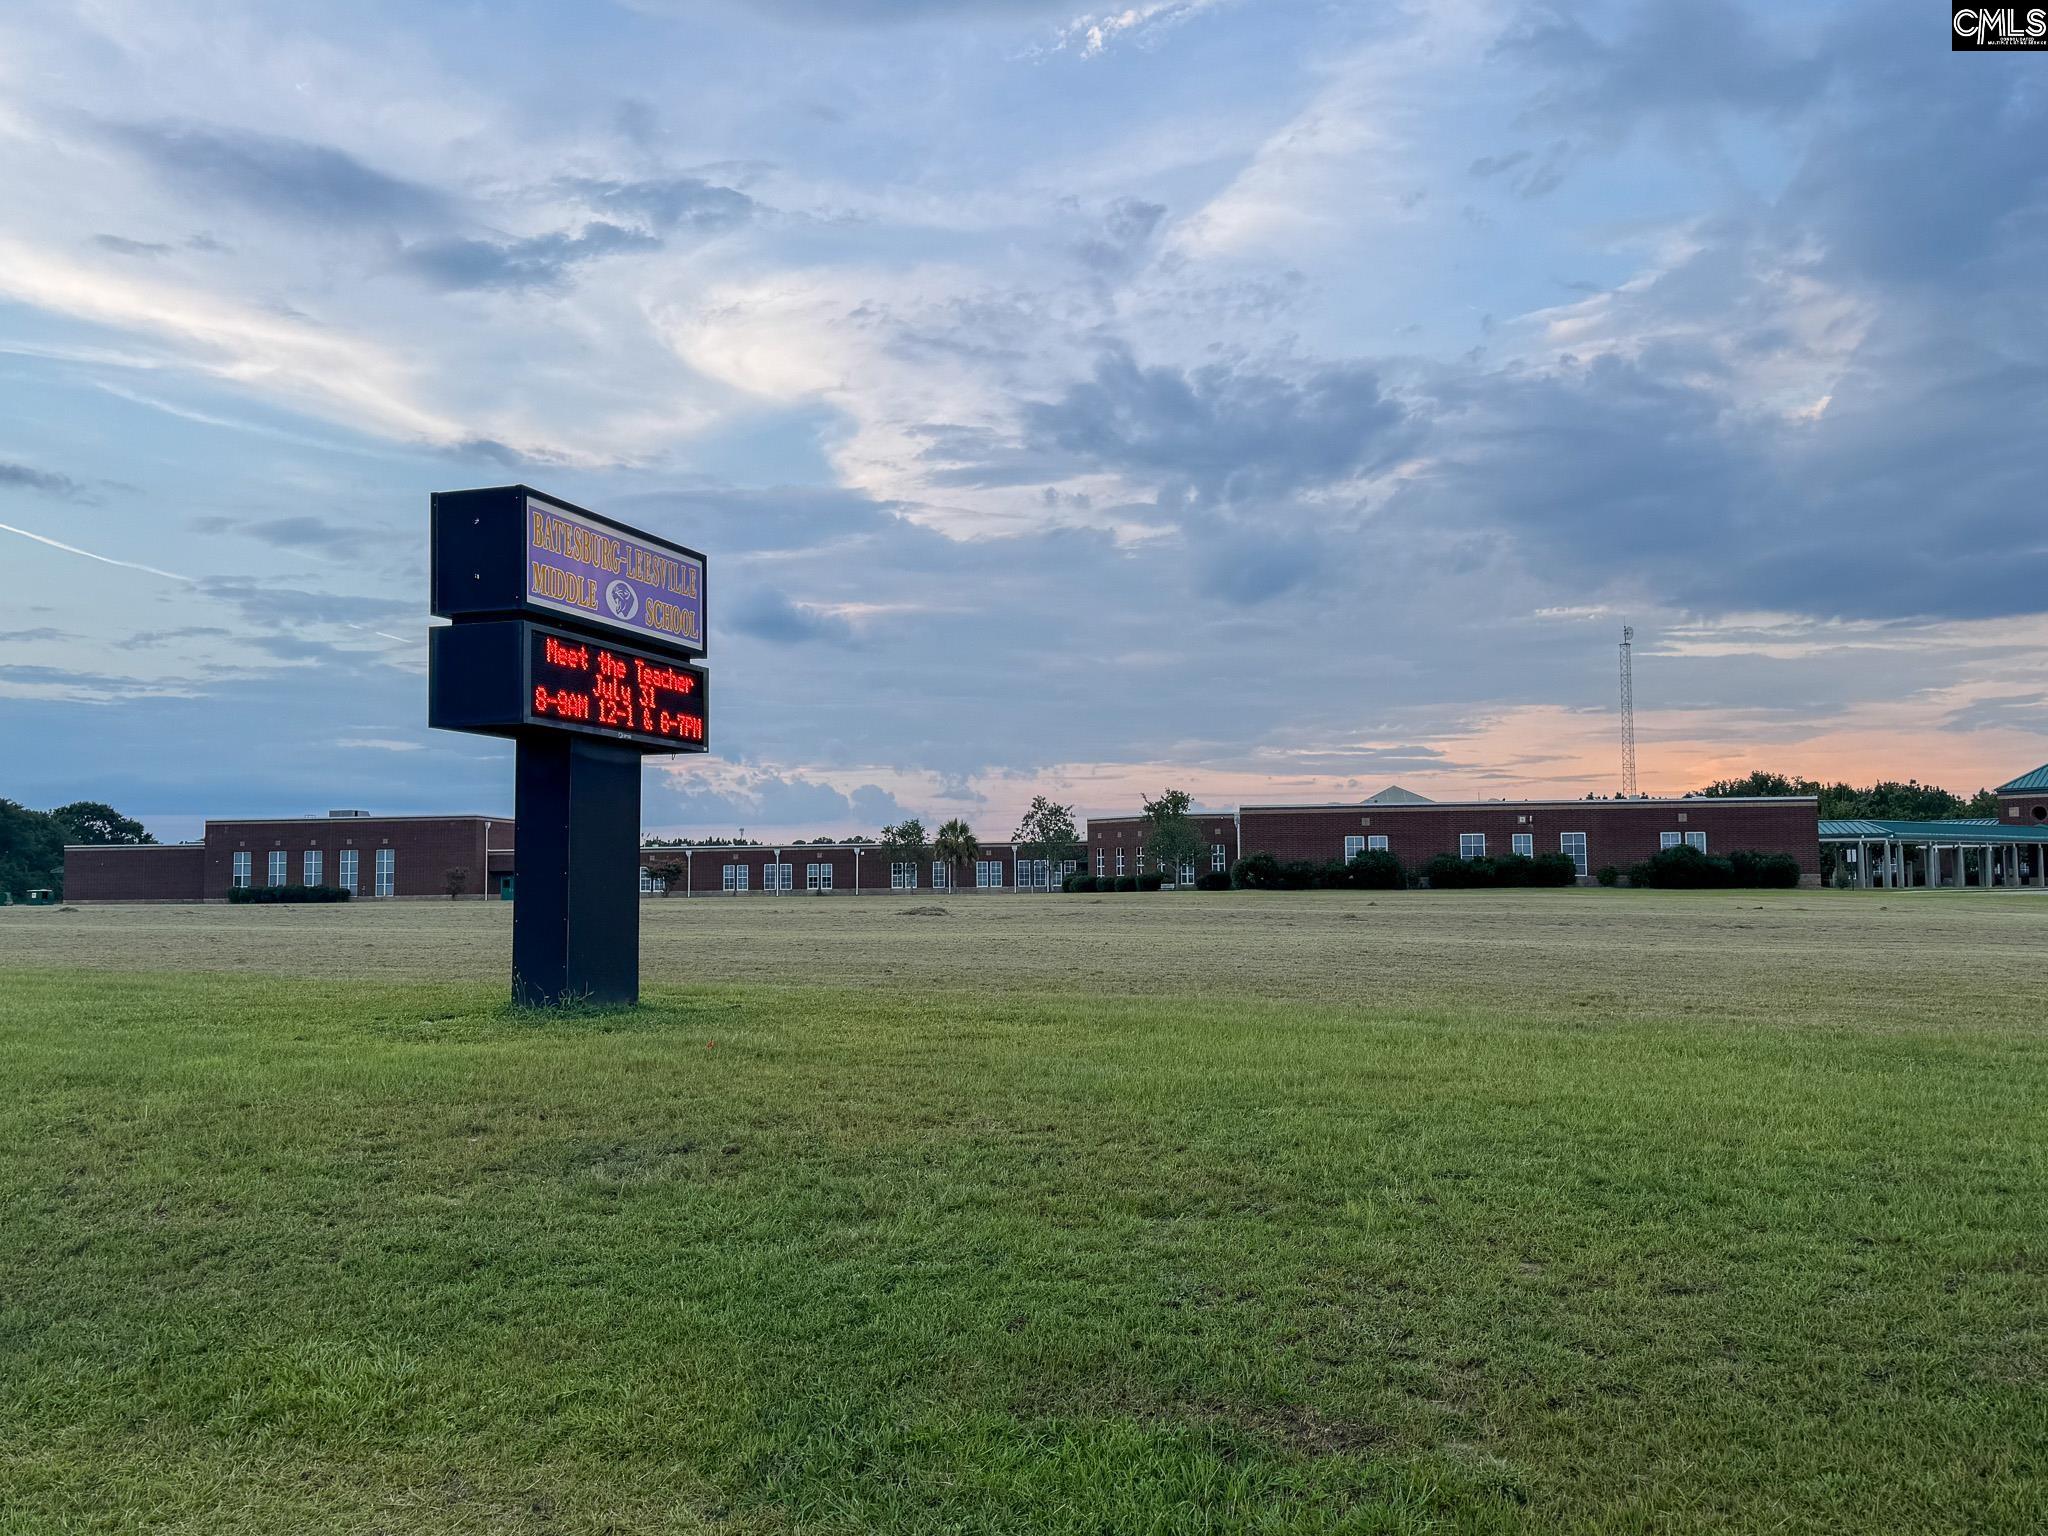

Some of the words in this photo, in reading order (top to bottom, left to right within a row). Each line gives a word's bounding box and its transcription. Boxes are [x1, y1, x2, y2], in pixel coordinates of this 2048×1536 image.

[532, 511, 698, 600] BATESBURG-LEESVILLE
[532, 560, 598, 611] MIDDLE
[645, 597, 698, 640] SCHOOL
[546, 637, 589, 671] Meet
[597, 651, 627, 679] the
[634, 659, 695, 695] Teacher
[592, 673, 631, 706] July
[638, 684, 656, 709] 31
[535, 685, 589, 719] 8-9AM
[598, 698, 634, 728] 12-1
[660, 711, 703, 739] 6-7PM
